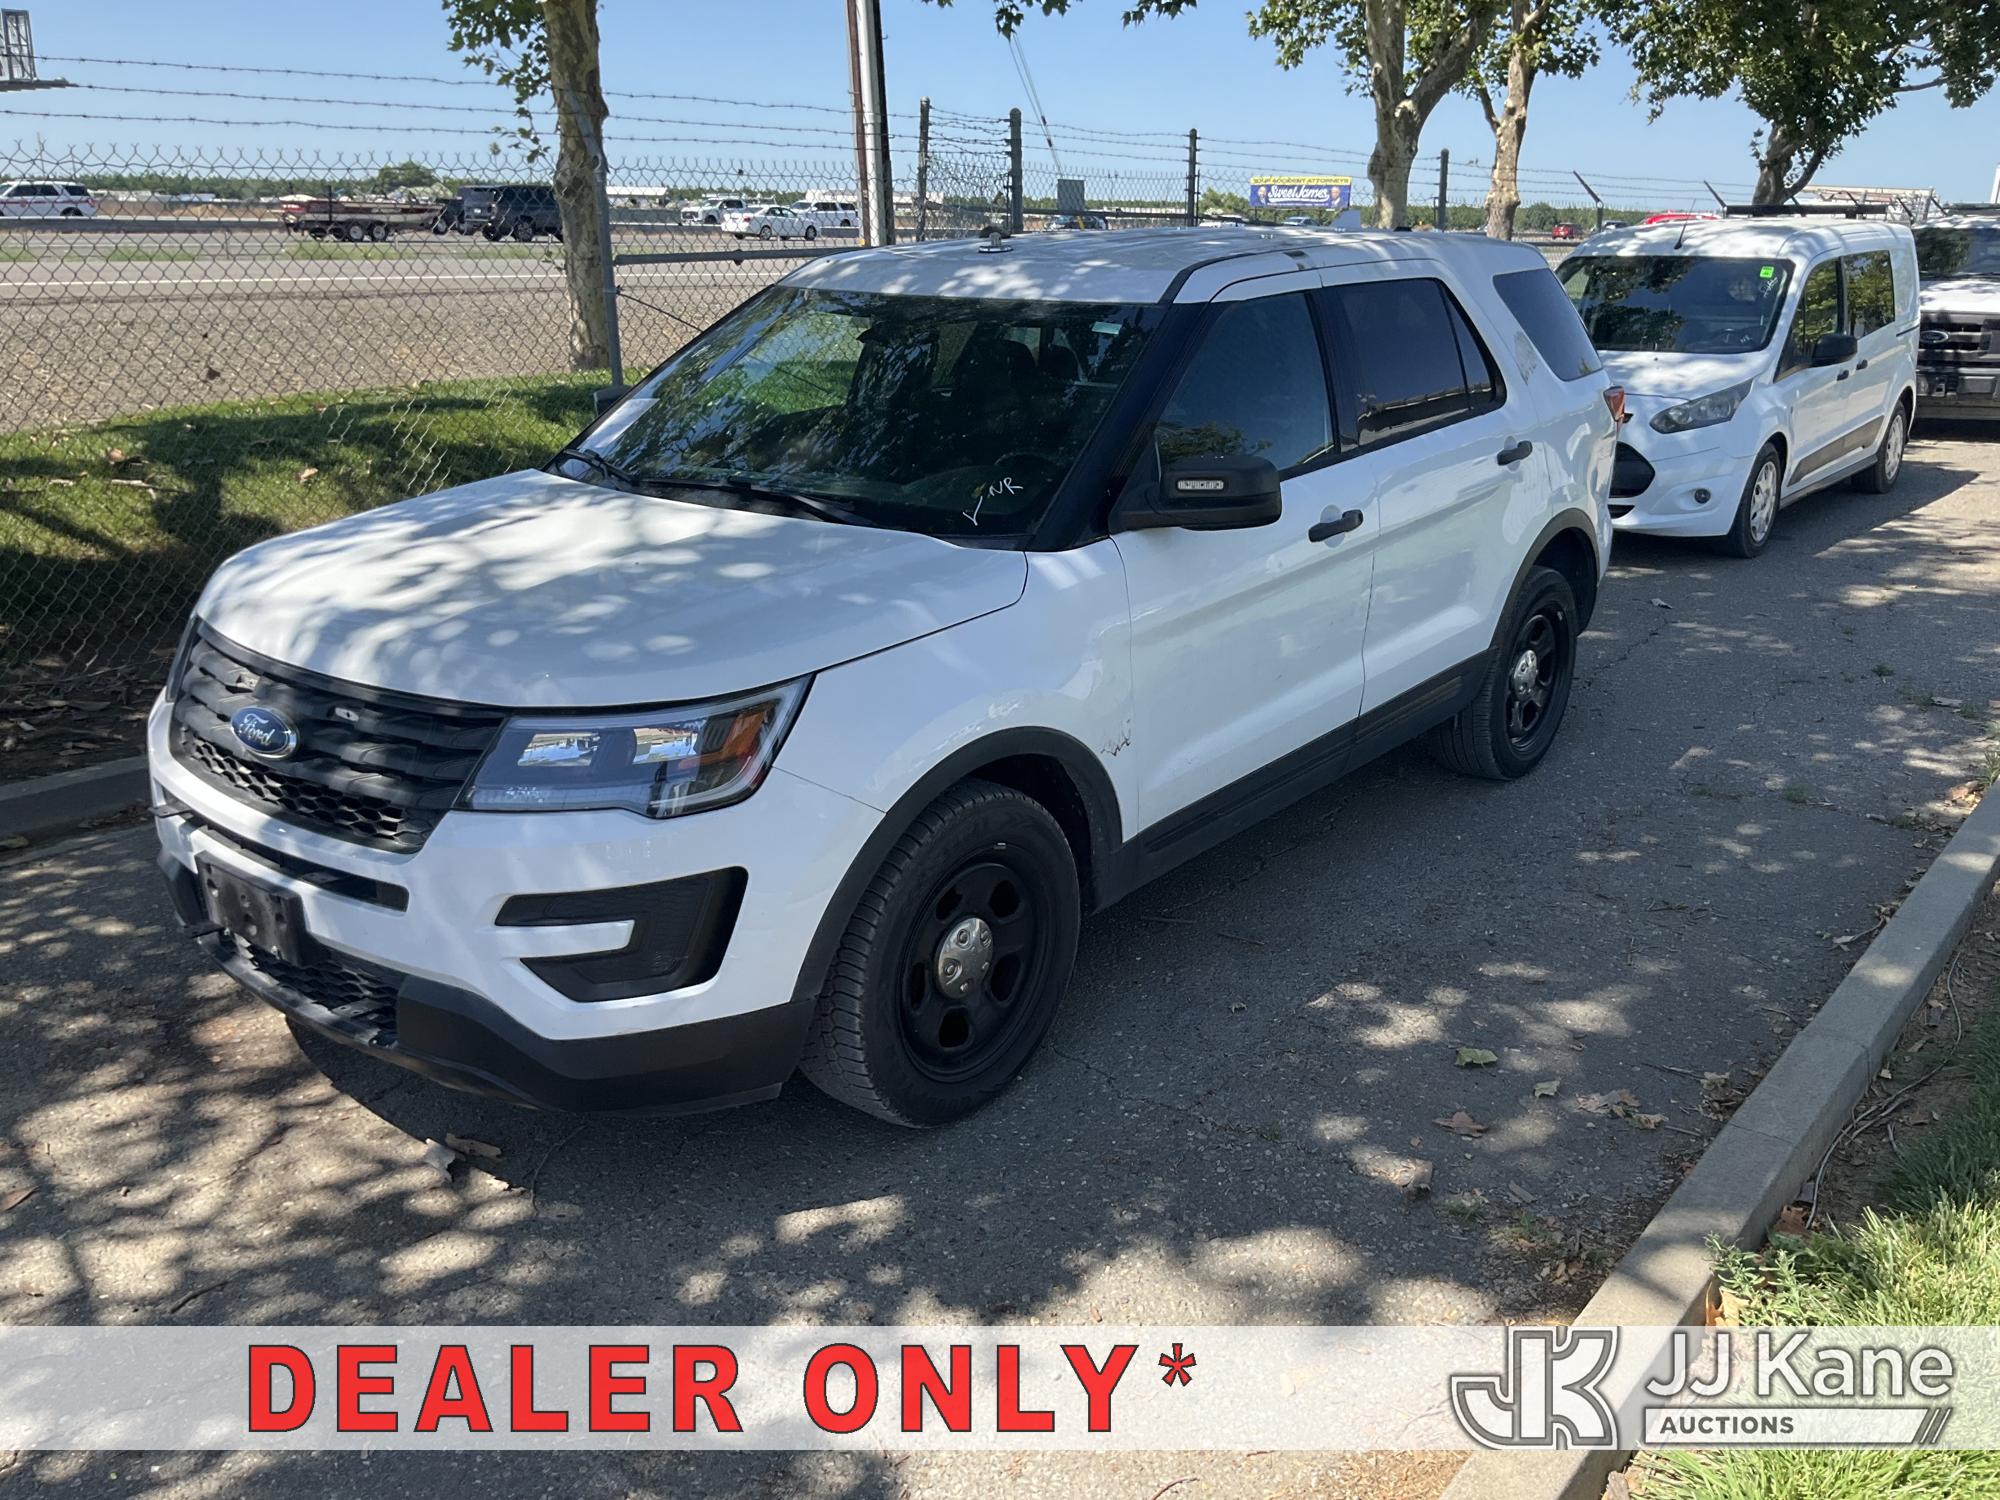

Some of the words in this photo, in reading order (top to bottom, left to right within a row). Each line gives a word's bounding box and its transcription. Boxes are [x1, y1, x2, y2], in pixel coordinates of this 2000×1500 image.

[1268, 185, 1297, 198] Sweet
[1296, 185, 1329, 199] James
[238, 713, 276, 746] Ford
